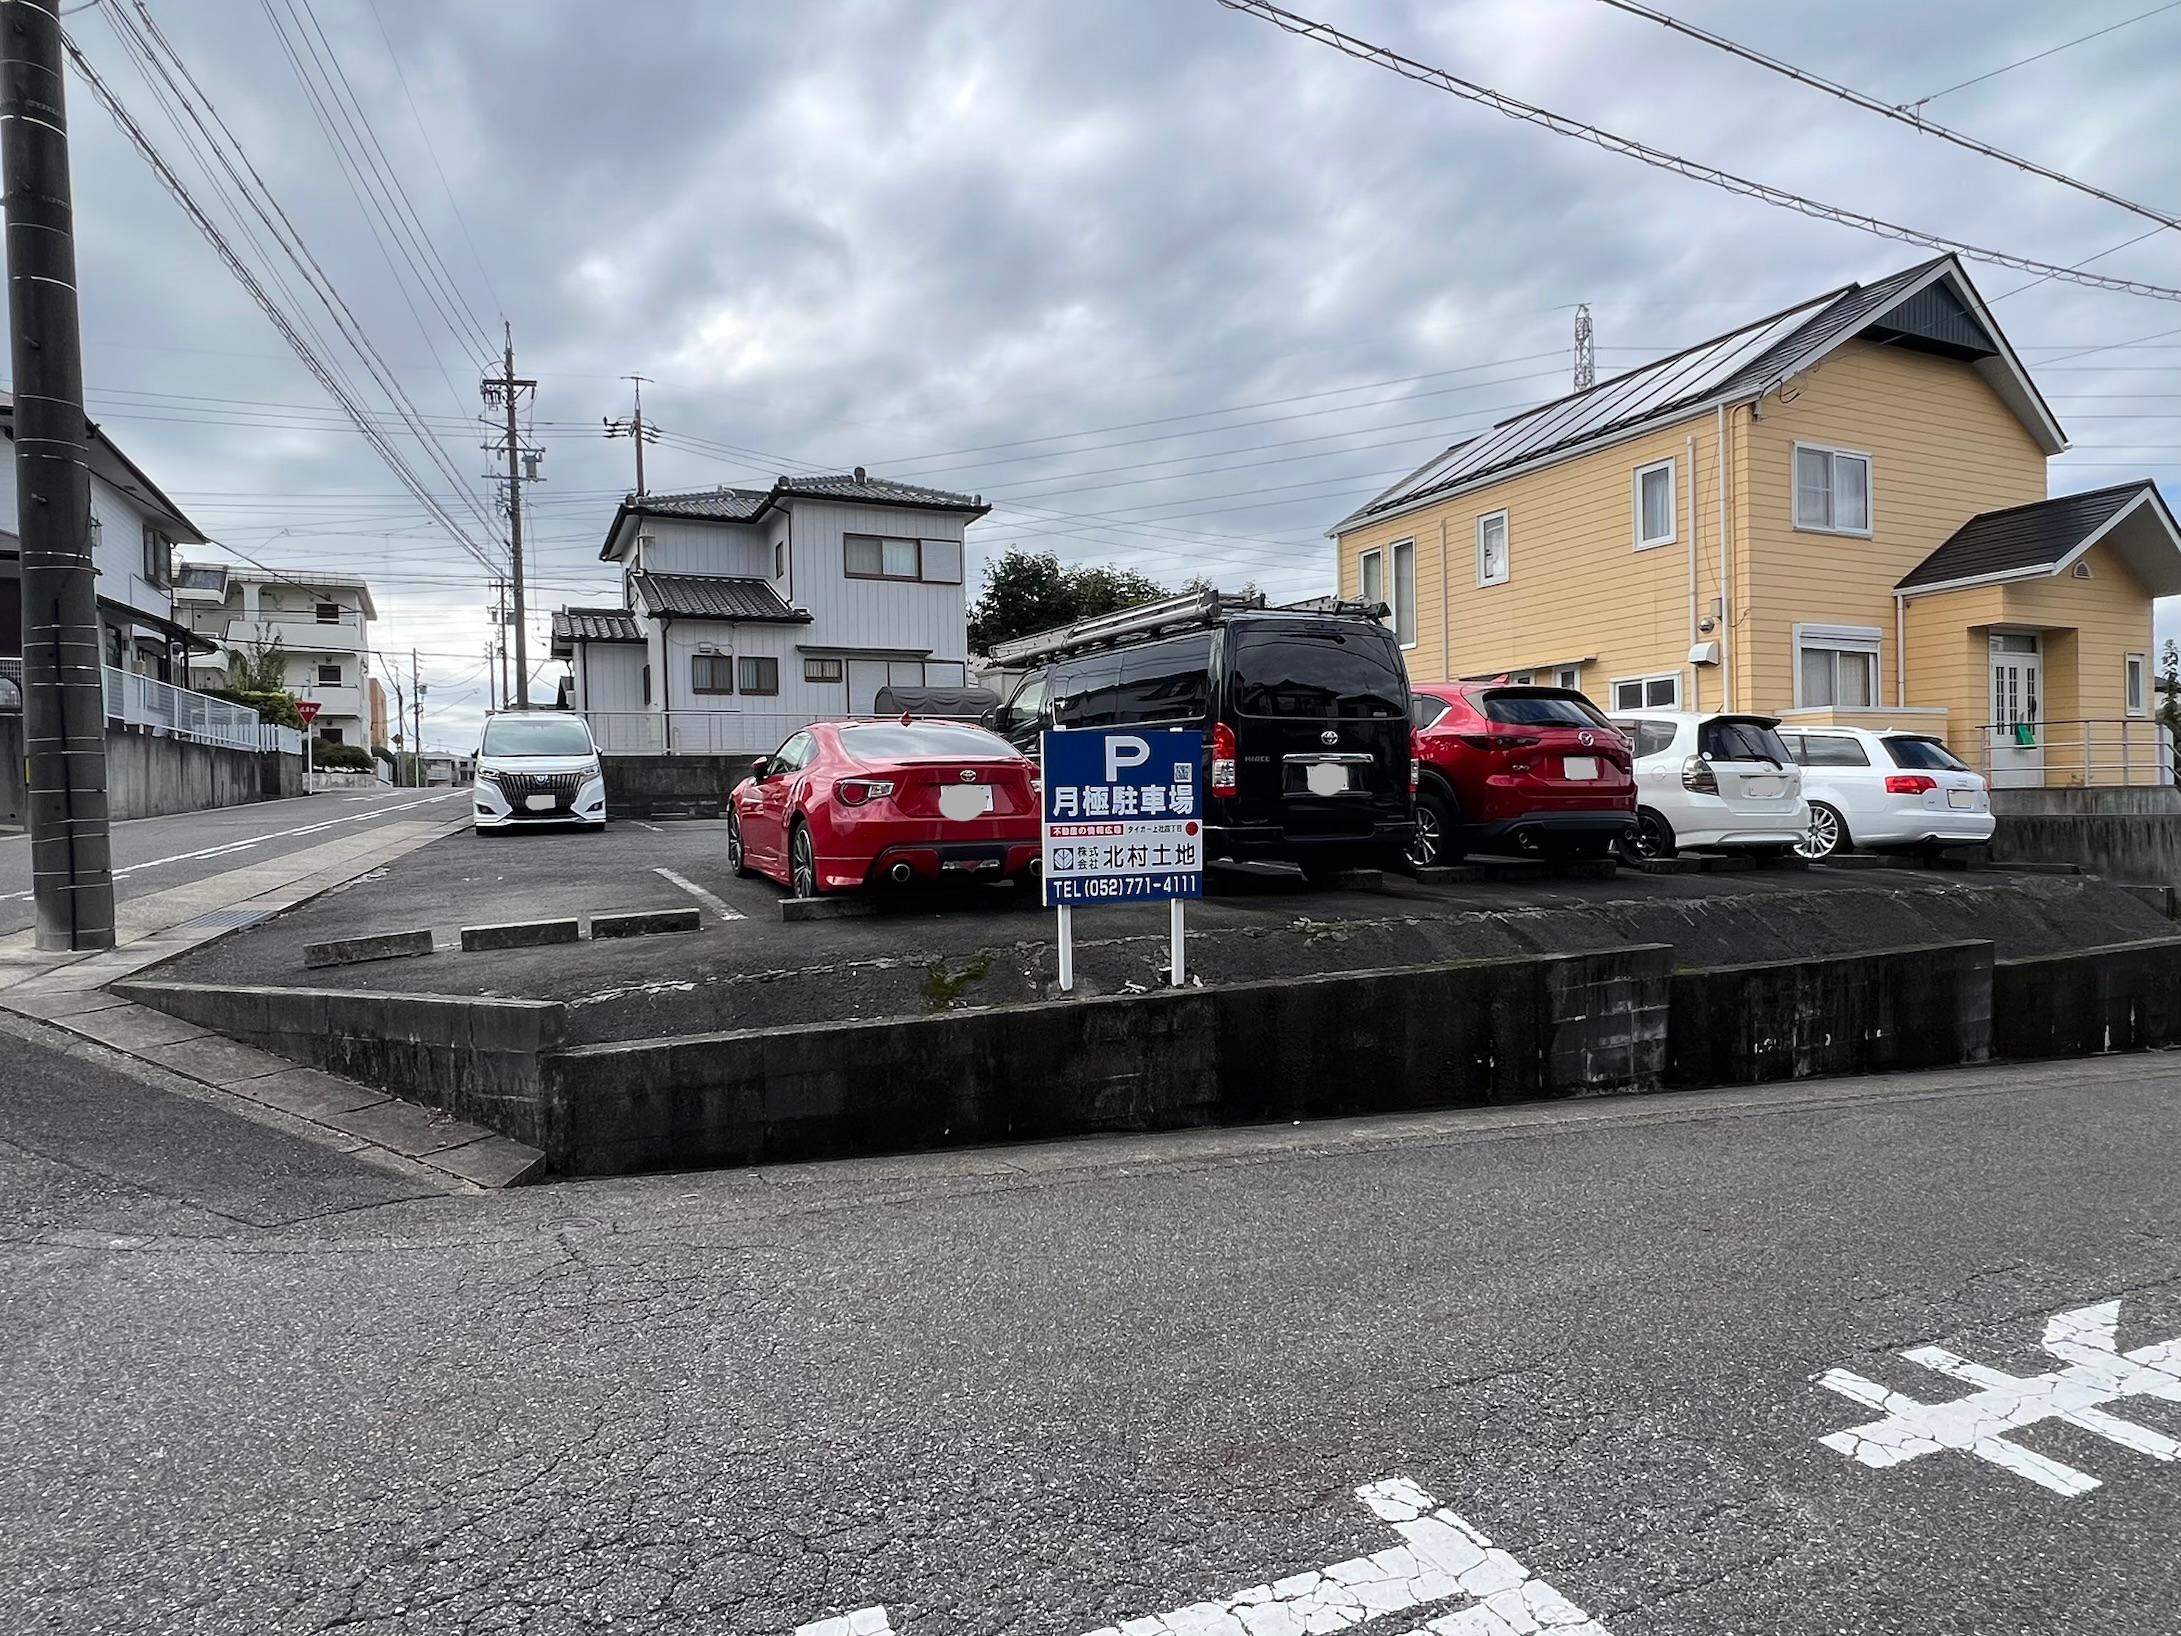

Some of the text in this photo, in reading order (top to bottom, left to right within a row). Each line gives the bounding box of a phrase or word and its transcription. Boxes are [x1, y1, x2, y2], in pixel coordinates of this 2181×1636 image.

[1105, 735, 1150, 782] P
[1053, 784, 1195, 817] 月極駐車場
[1103, 843, 1195, 869] 北村土地
[1053, 875, 1196, 898] TEL (052)771-4111
